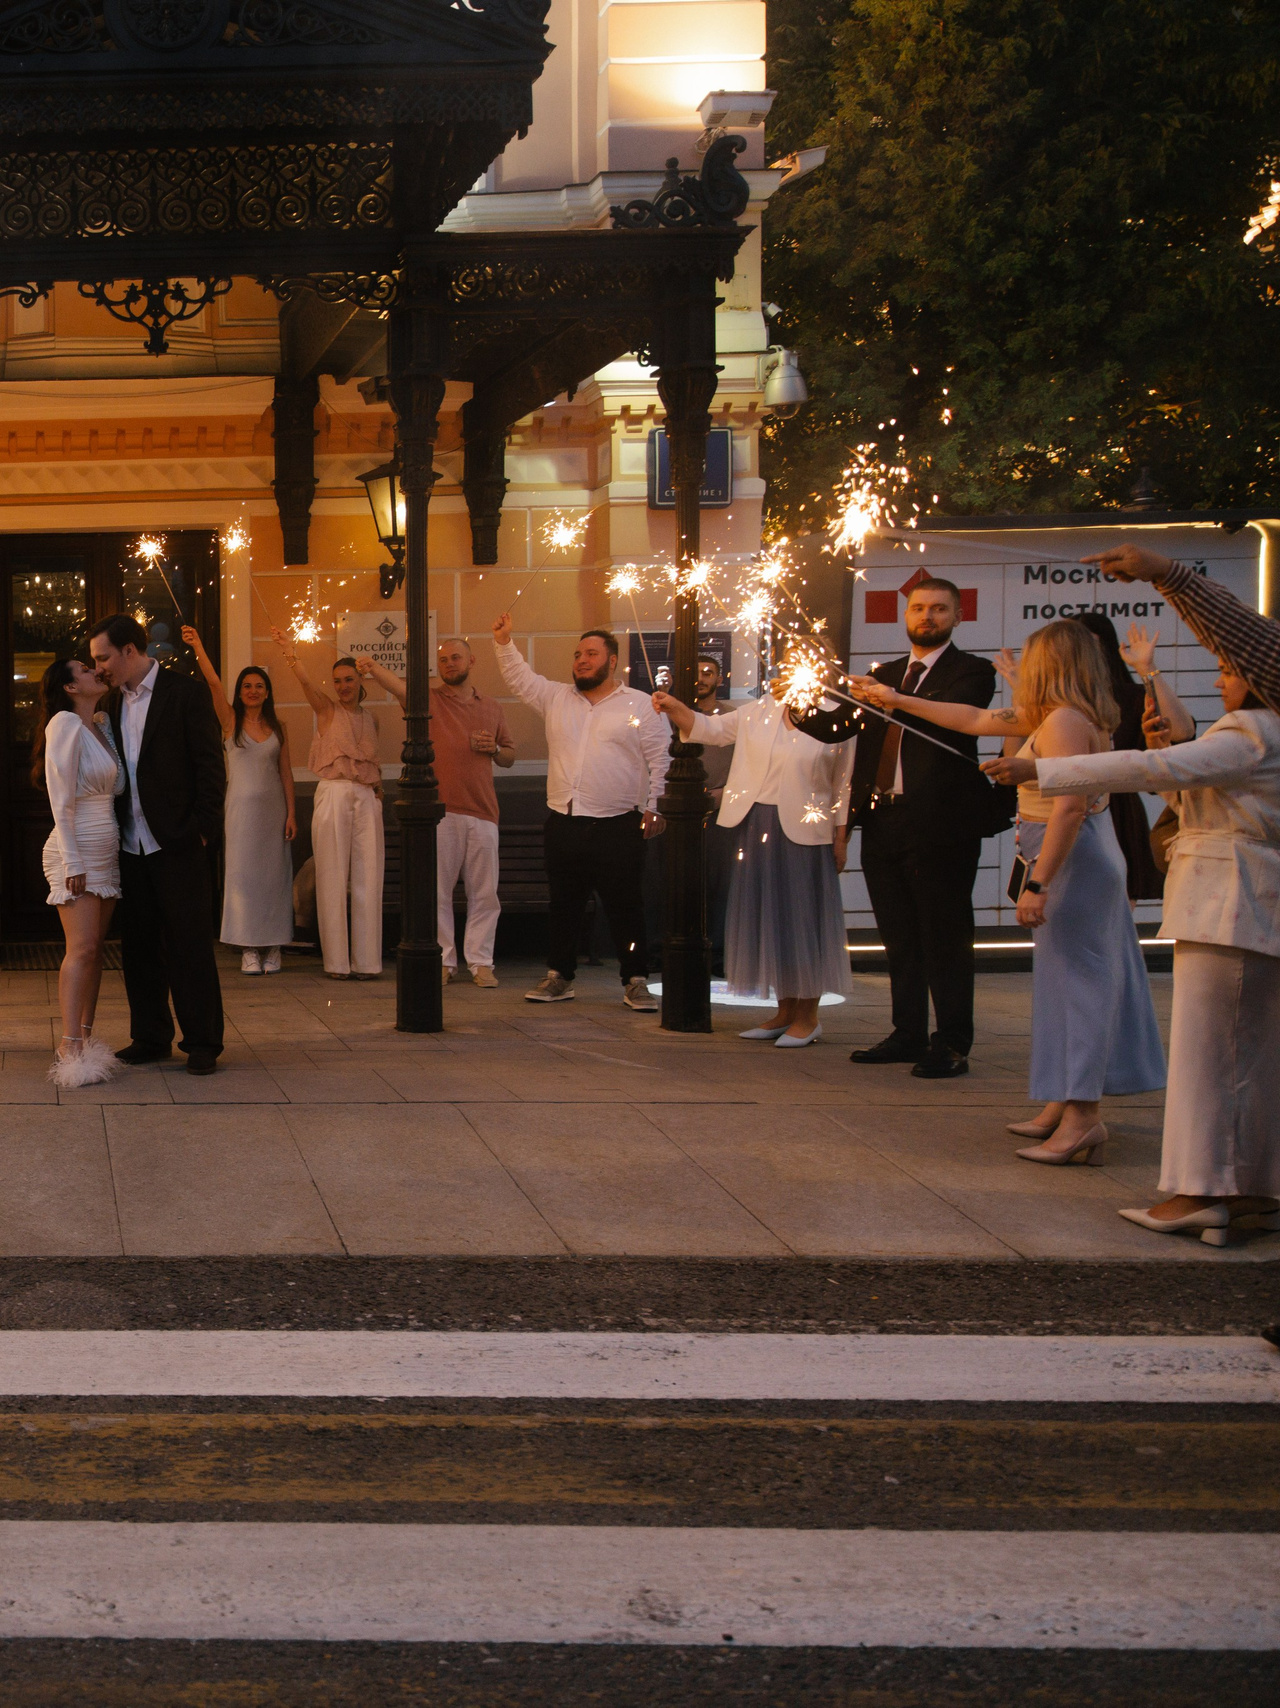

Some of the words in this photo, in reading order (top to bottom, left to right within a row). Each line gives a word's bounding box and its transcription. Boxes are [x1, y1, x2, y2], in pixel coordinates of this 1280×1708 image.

[1022, 602, 1165, 620] постамат
[349, 641, 407, 652] РОССИЙСК
[371, 653, 403, 662] ФОНД
